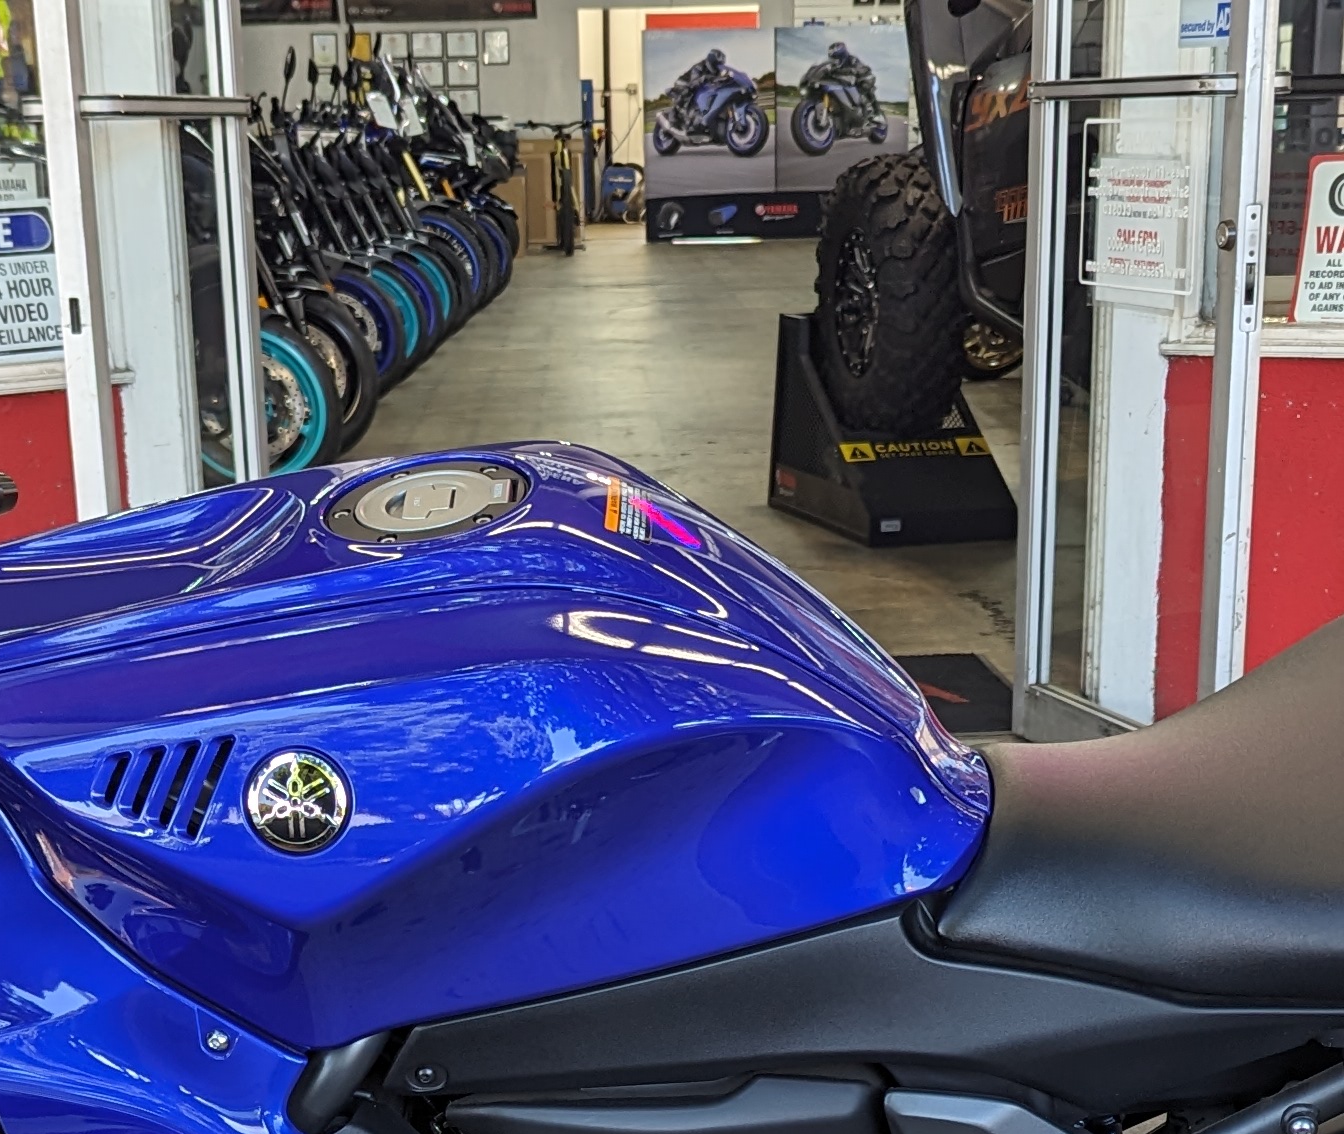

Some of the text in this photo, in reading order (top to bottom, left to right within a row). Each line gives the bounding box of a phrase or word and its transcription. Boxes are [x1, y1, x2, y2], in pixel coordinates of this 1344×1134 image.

[1180, 21, 1204, 34] secured
[1205, 20, 1215, 34] by
[8, 260, 50, 276] UNDER
[1326, 258, 1342, 268] ALL
[7, 278, 55, 299] HOUR
[1304, 281, 1316, 290] TO
[1318, 281, 1333, 290] AID
[1335, 281, 1344, 290] IN
[1308, 292, 1320, 302] OF
[1322, 292, 1341, 302] ANY
[874, 439, 954, 454] CAUTION
